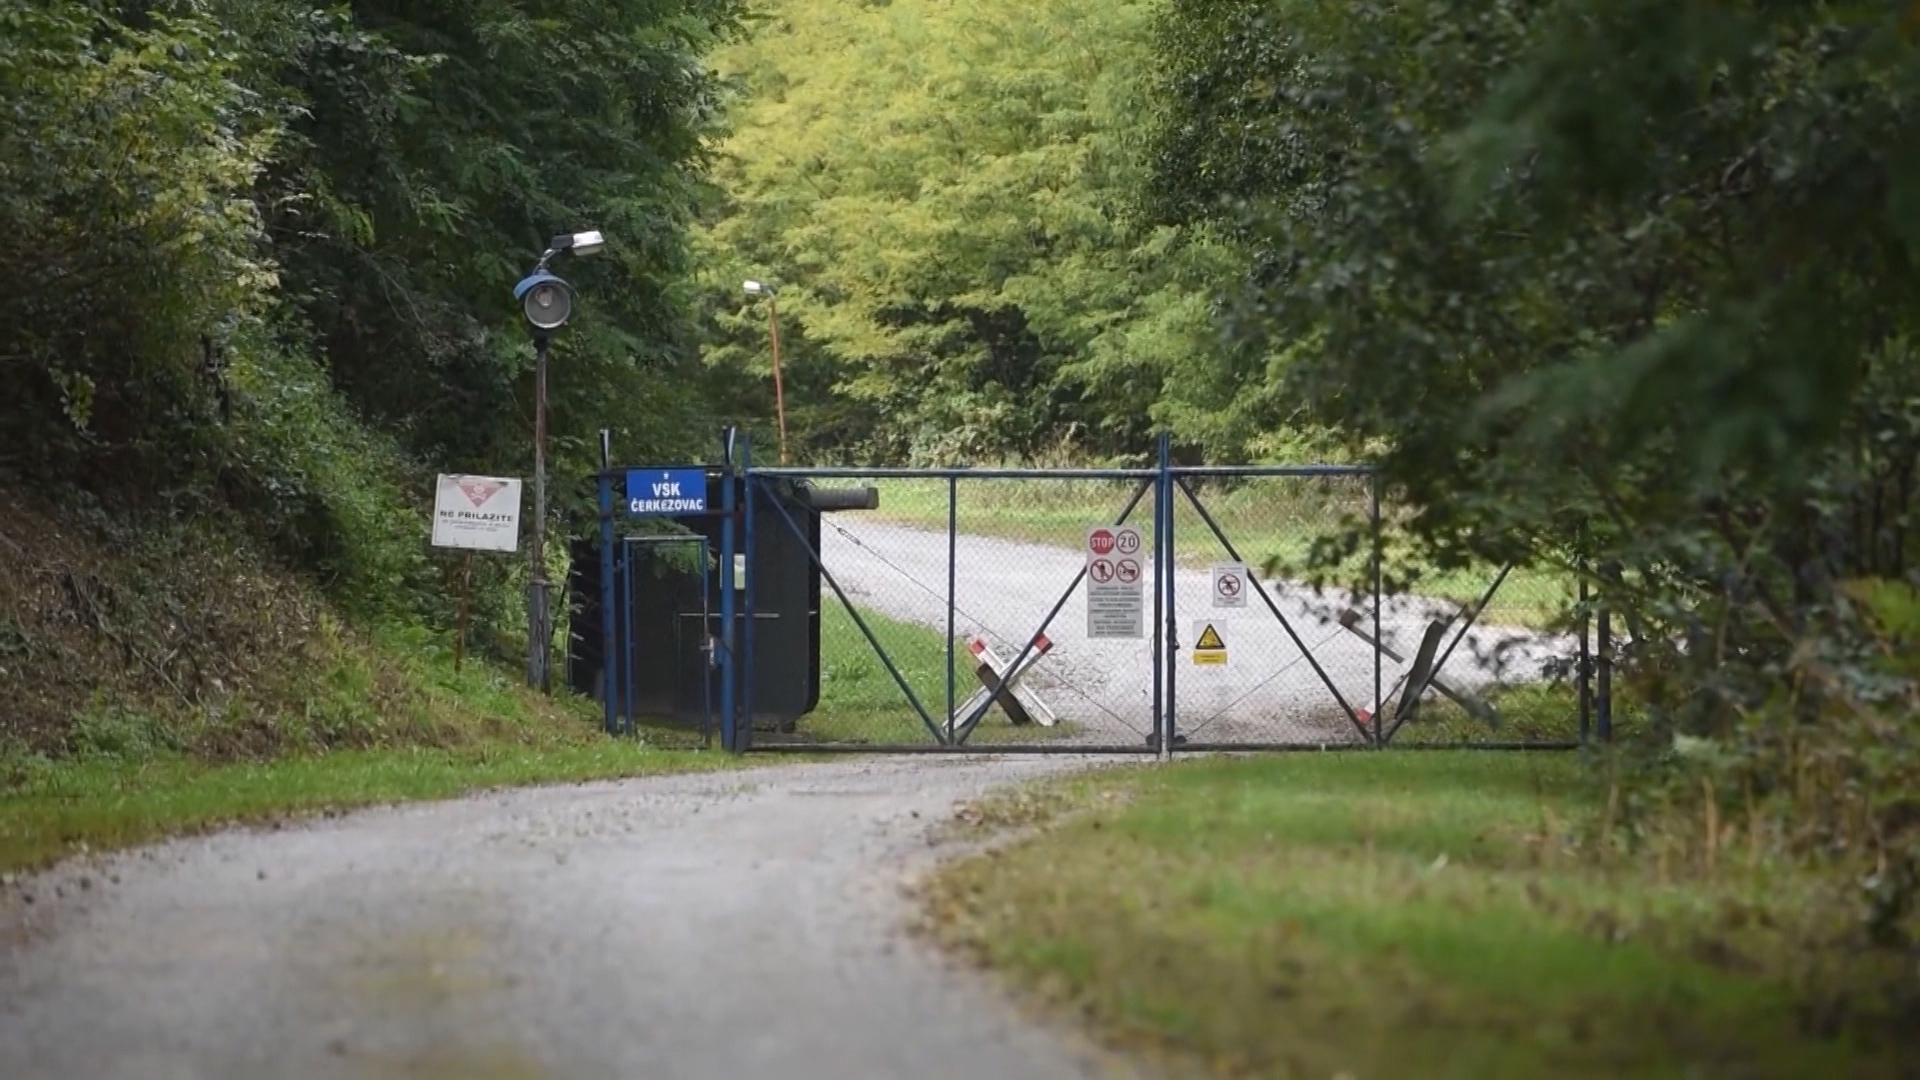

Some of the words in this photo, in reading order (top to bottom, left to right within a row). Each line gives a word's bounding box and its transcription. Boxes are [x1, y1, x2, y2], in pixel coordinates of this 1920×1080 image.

[652, 482, 681, 497] VSK
[631, 497, 704, 512] ČERKEZOVAC
[440, 510, 455, 518] NE
[458, 511, 514, 522] PRILAZITE
[1091, 537, 1114, 549] STOP
[1120, 535, 1136, 548] 20
